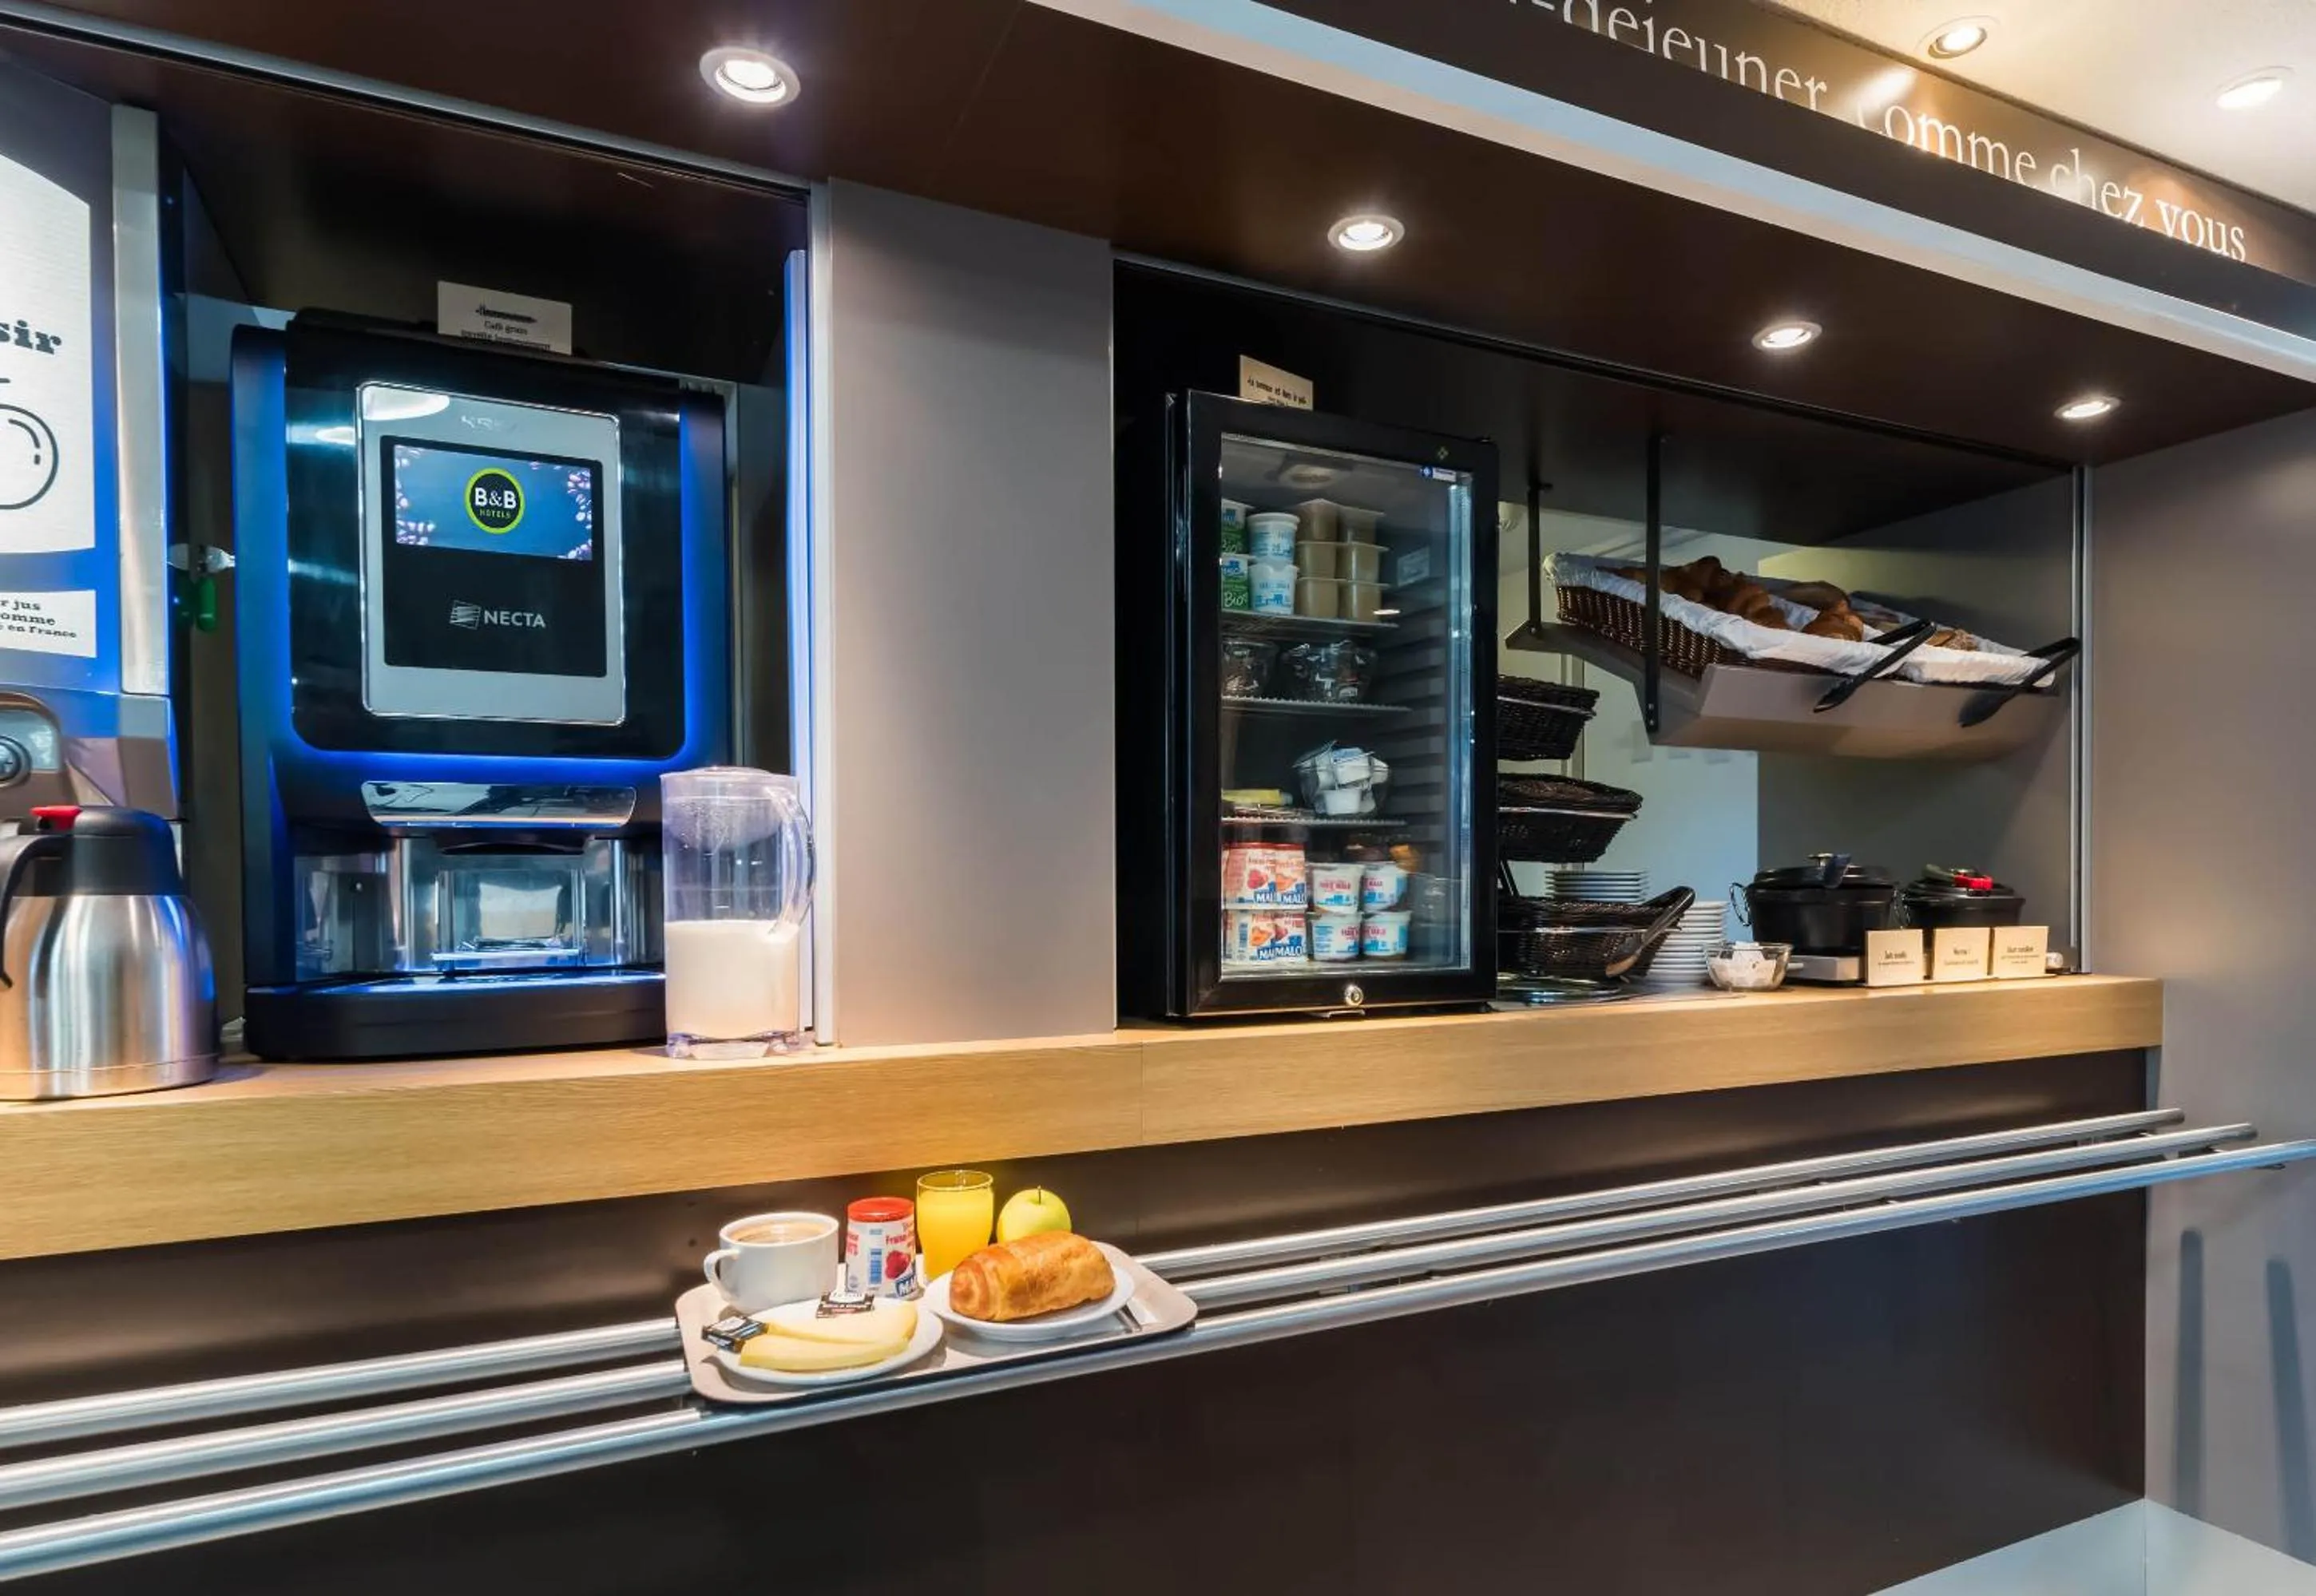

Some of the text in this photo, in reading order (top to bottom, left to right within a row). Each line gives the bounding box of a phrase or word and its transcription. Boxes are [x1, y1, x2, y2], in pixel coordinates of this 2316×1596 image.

[2155, 199, 2247, 262] vous
[475, 487, 518, 509] B&B
[480, 509, 511, 519] HOTELS
[12, 600, 41, 610] jus
[483, 609, 546, 628] NECTA
